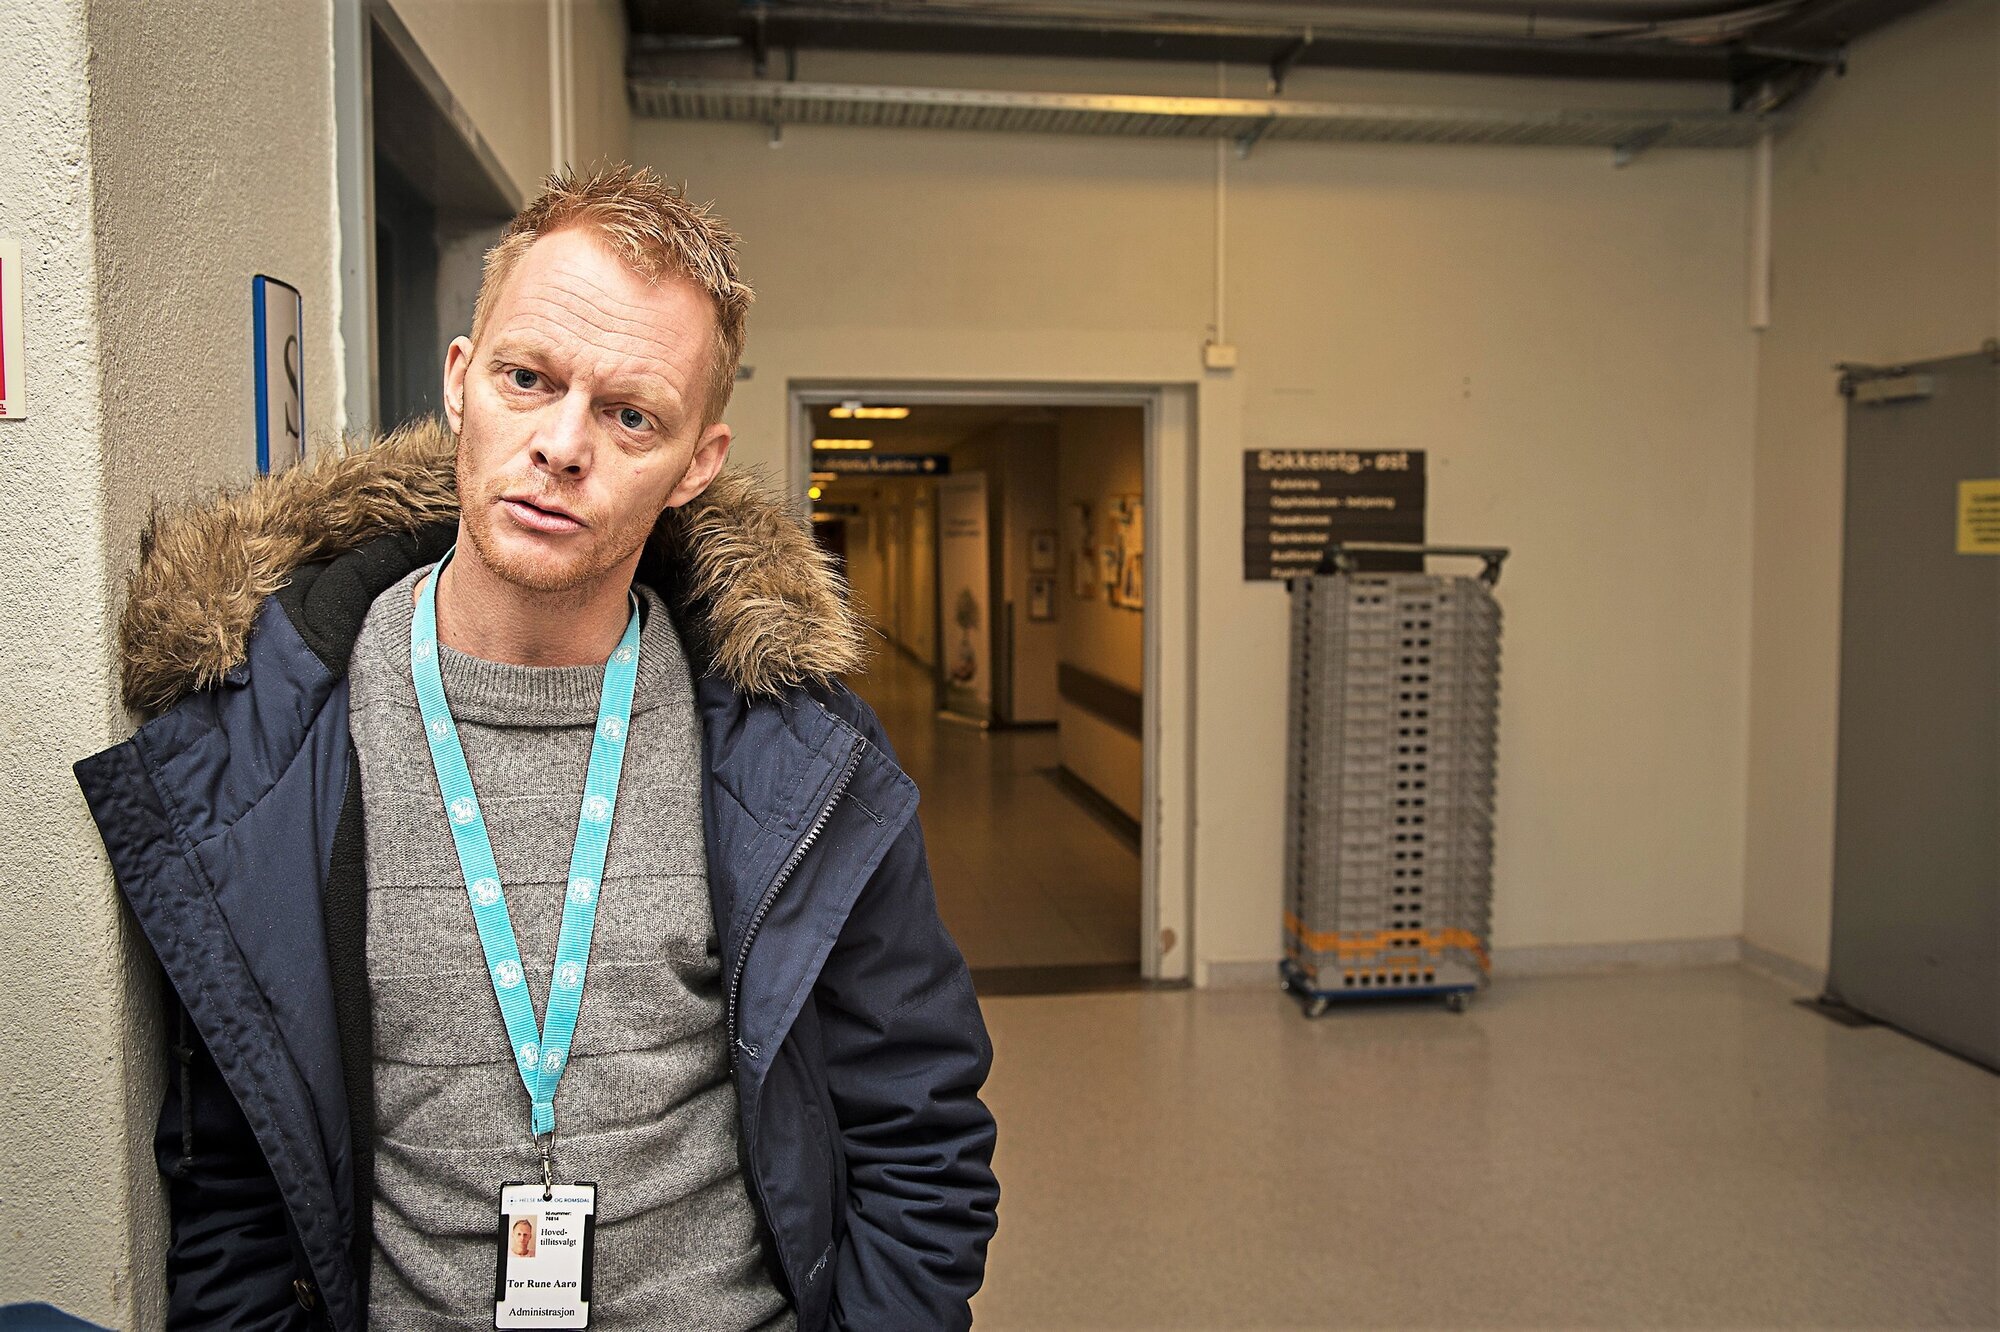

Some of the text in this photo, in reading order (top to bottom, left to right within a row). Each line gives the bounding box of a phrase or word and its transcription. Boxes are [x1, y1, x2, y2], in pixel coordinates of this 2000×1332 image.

[541, 1228, 568, 1236] Hoved-
[540, 1238, 577, 1247] tillitsvalgt
[507, 1279, 525, 1288] Tor
[527, 1279, 552, 1288] Rune
[508, 1307, 575, 1318] Administrasjon
